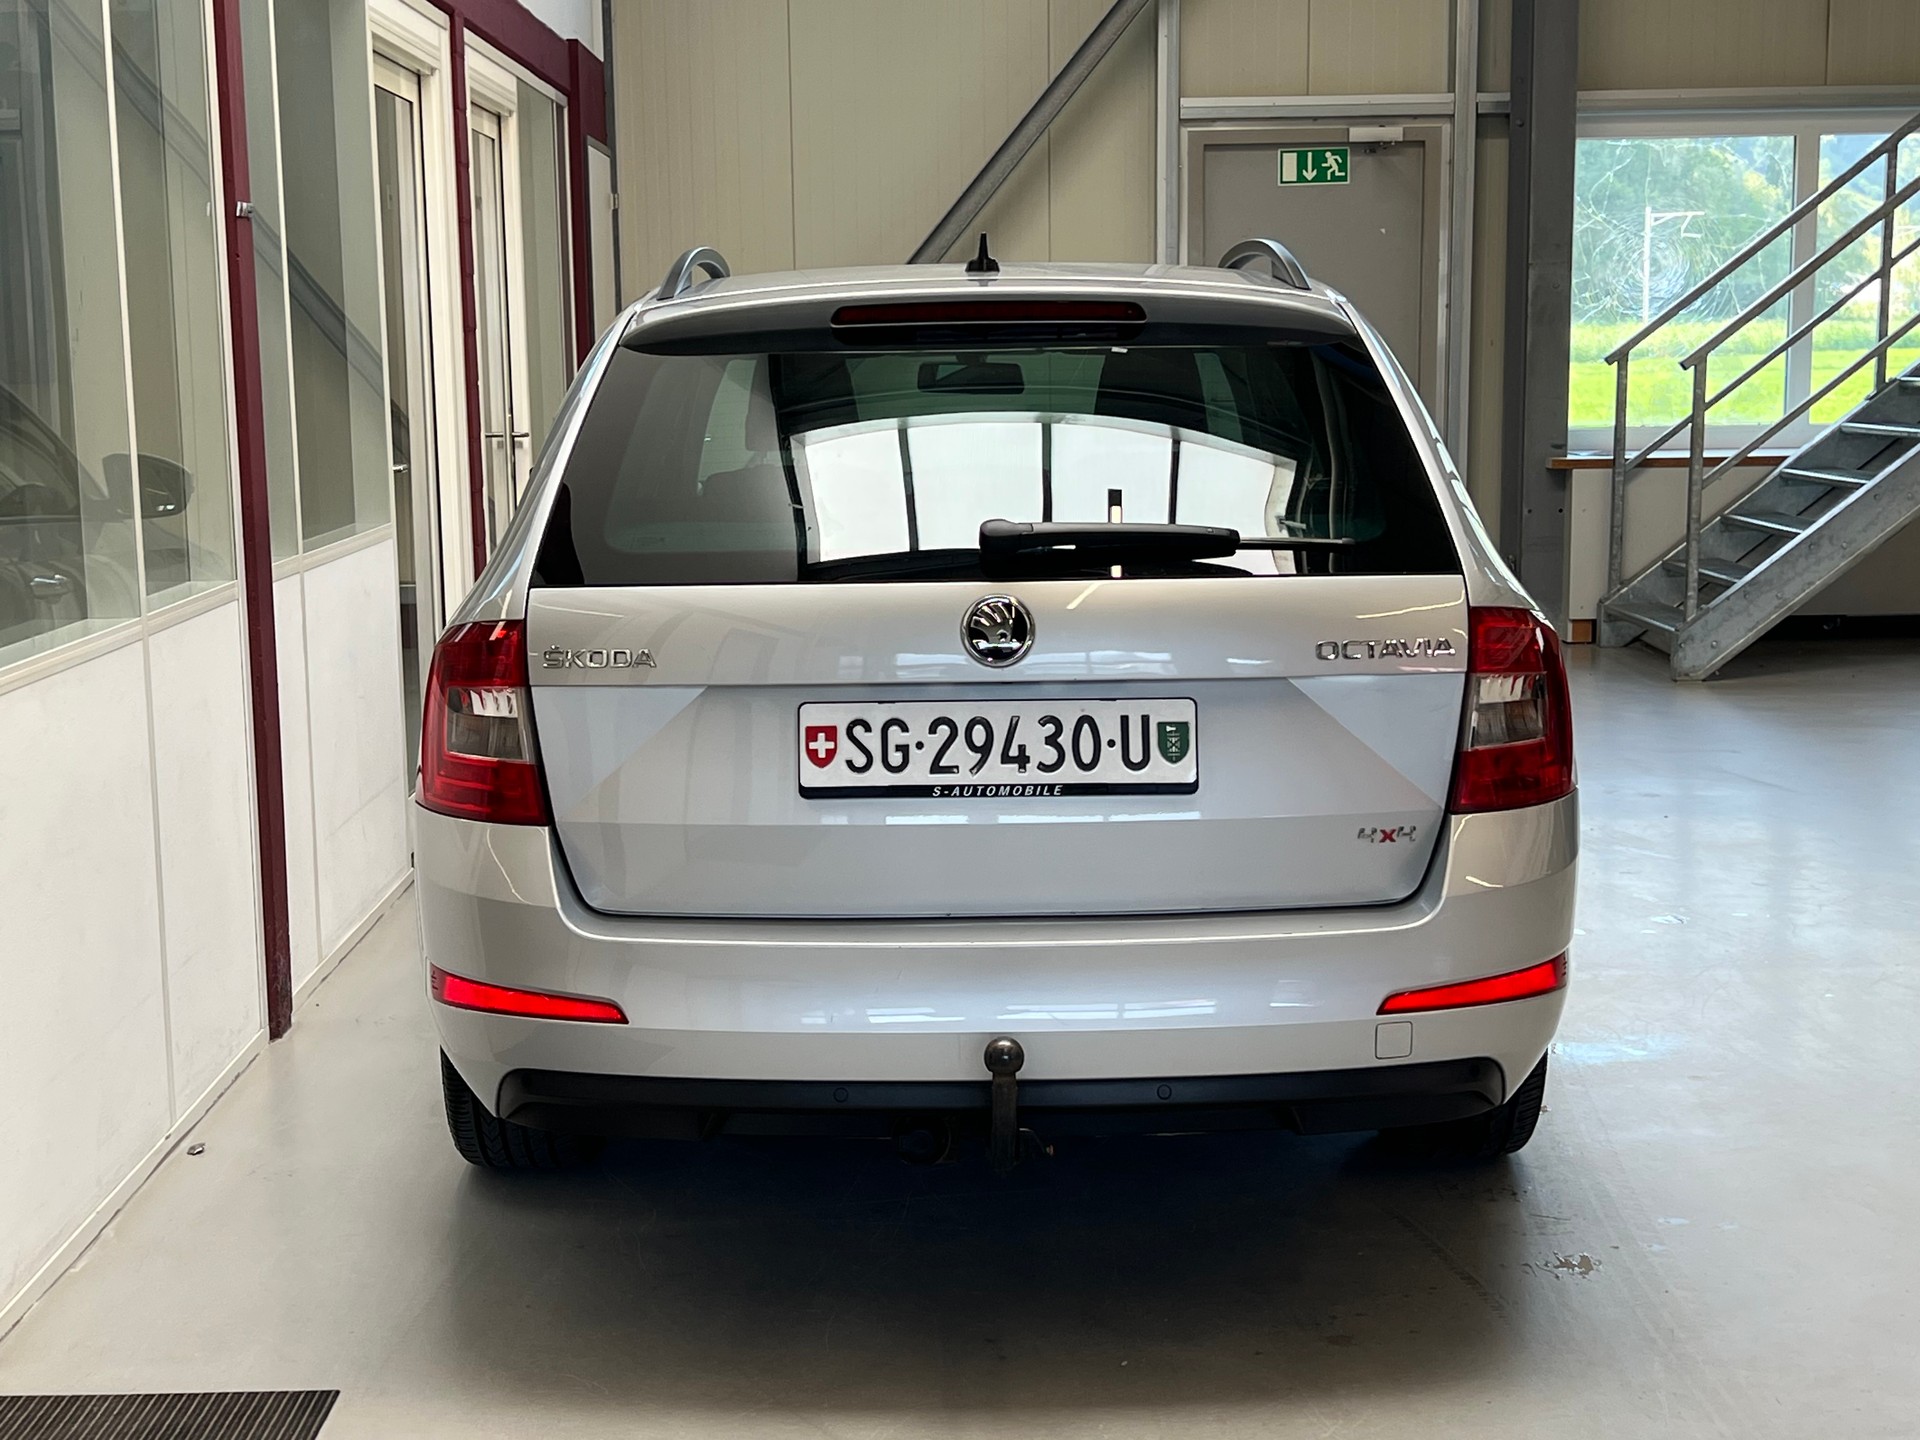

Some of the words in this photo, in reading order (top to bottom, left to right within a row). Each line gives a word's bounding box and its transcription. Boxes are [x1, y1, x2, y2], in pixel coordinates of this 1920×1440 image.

[542, 644, 657, 668] ŠKODA
[1315, 637, 1456, 660] OCTAVIA
[932, 784, 1063, 798] S-AUTOMOBILE
